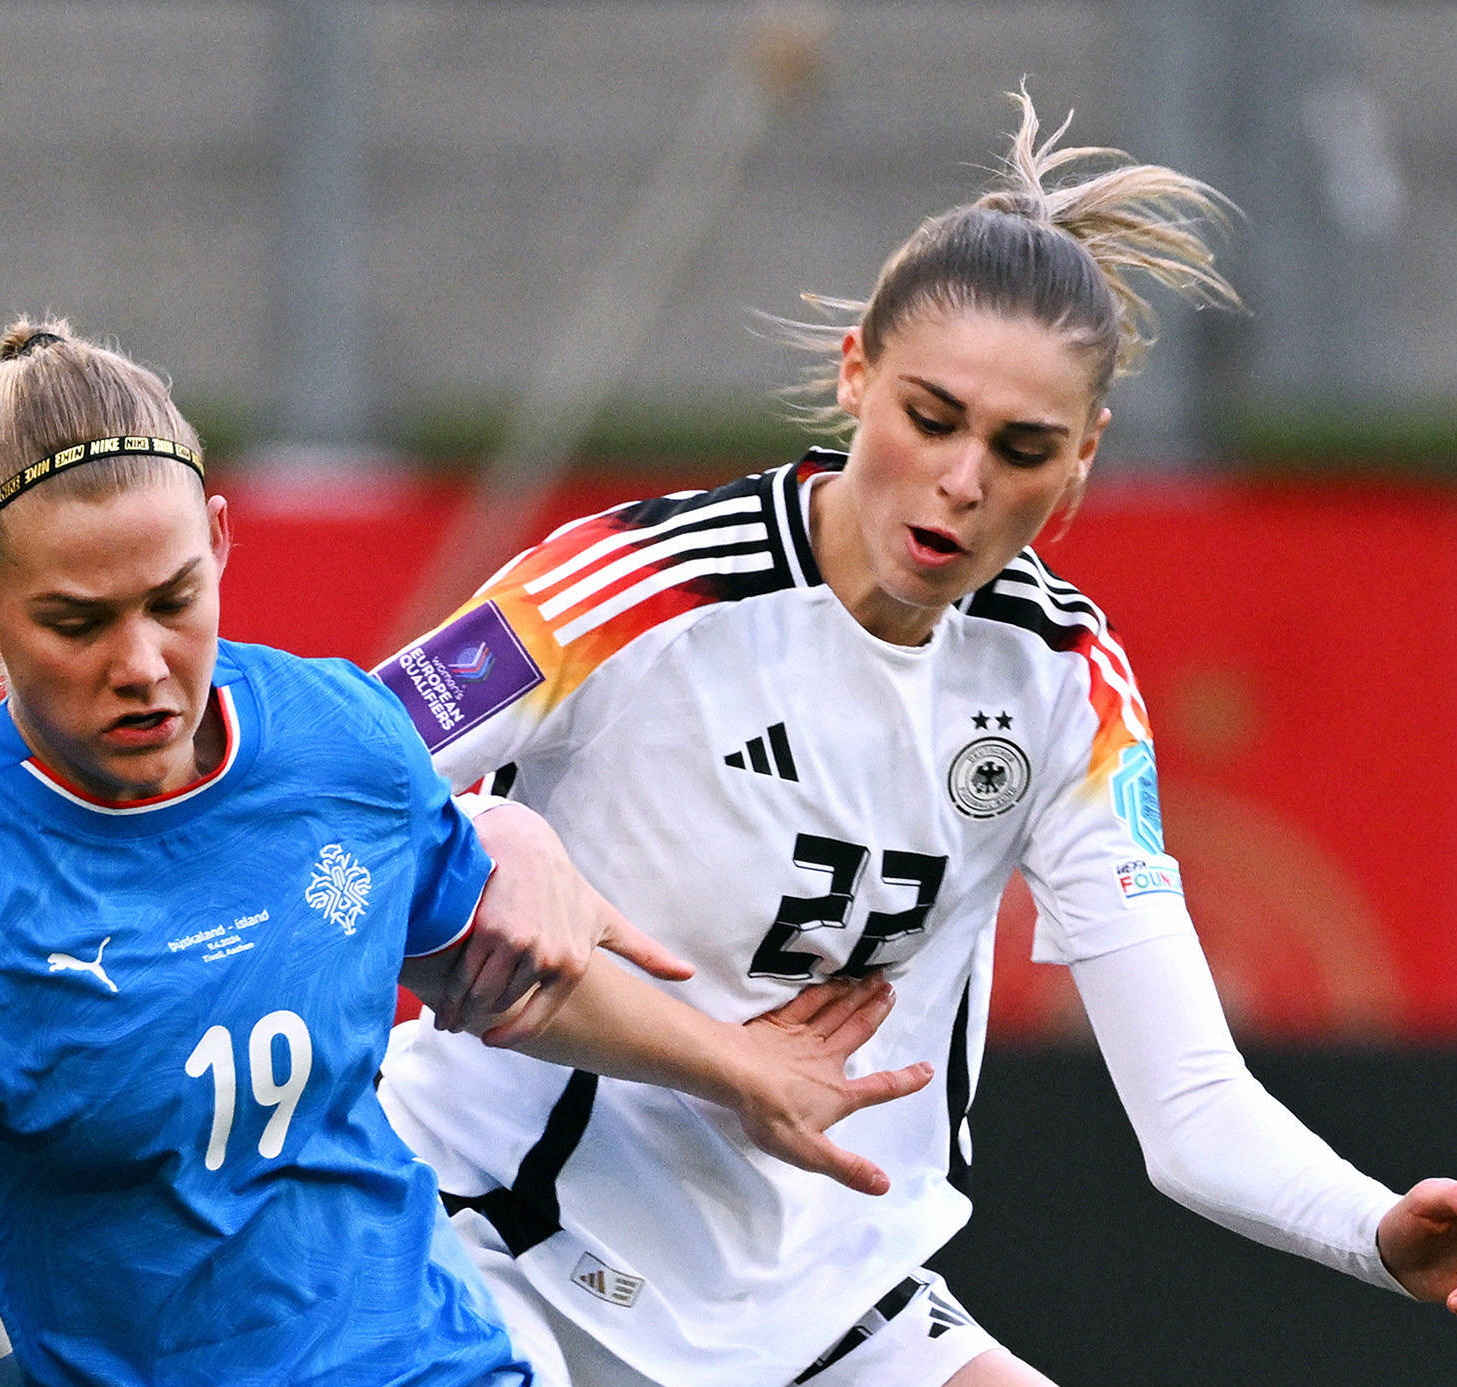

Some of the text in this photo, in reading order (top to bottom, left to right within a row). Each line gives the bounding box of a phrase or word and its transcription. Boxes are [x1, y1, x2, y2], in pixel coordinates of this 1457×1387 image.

[90, 437, 120, 455] NIKE
[125, 437, 150, 450] NIKE
[399, 654, 455, 731] QUALIFIERS
[410, 647, 464, 723] EUROPEAN
[747, 832, 949, 982] 22
[184, 1009, 313, 1171] 19
